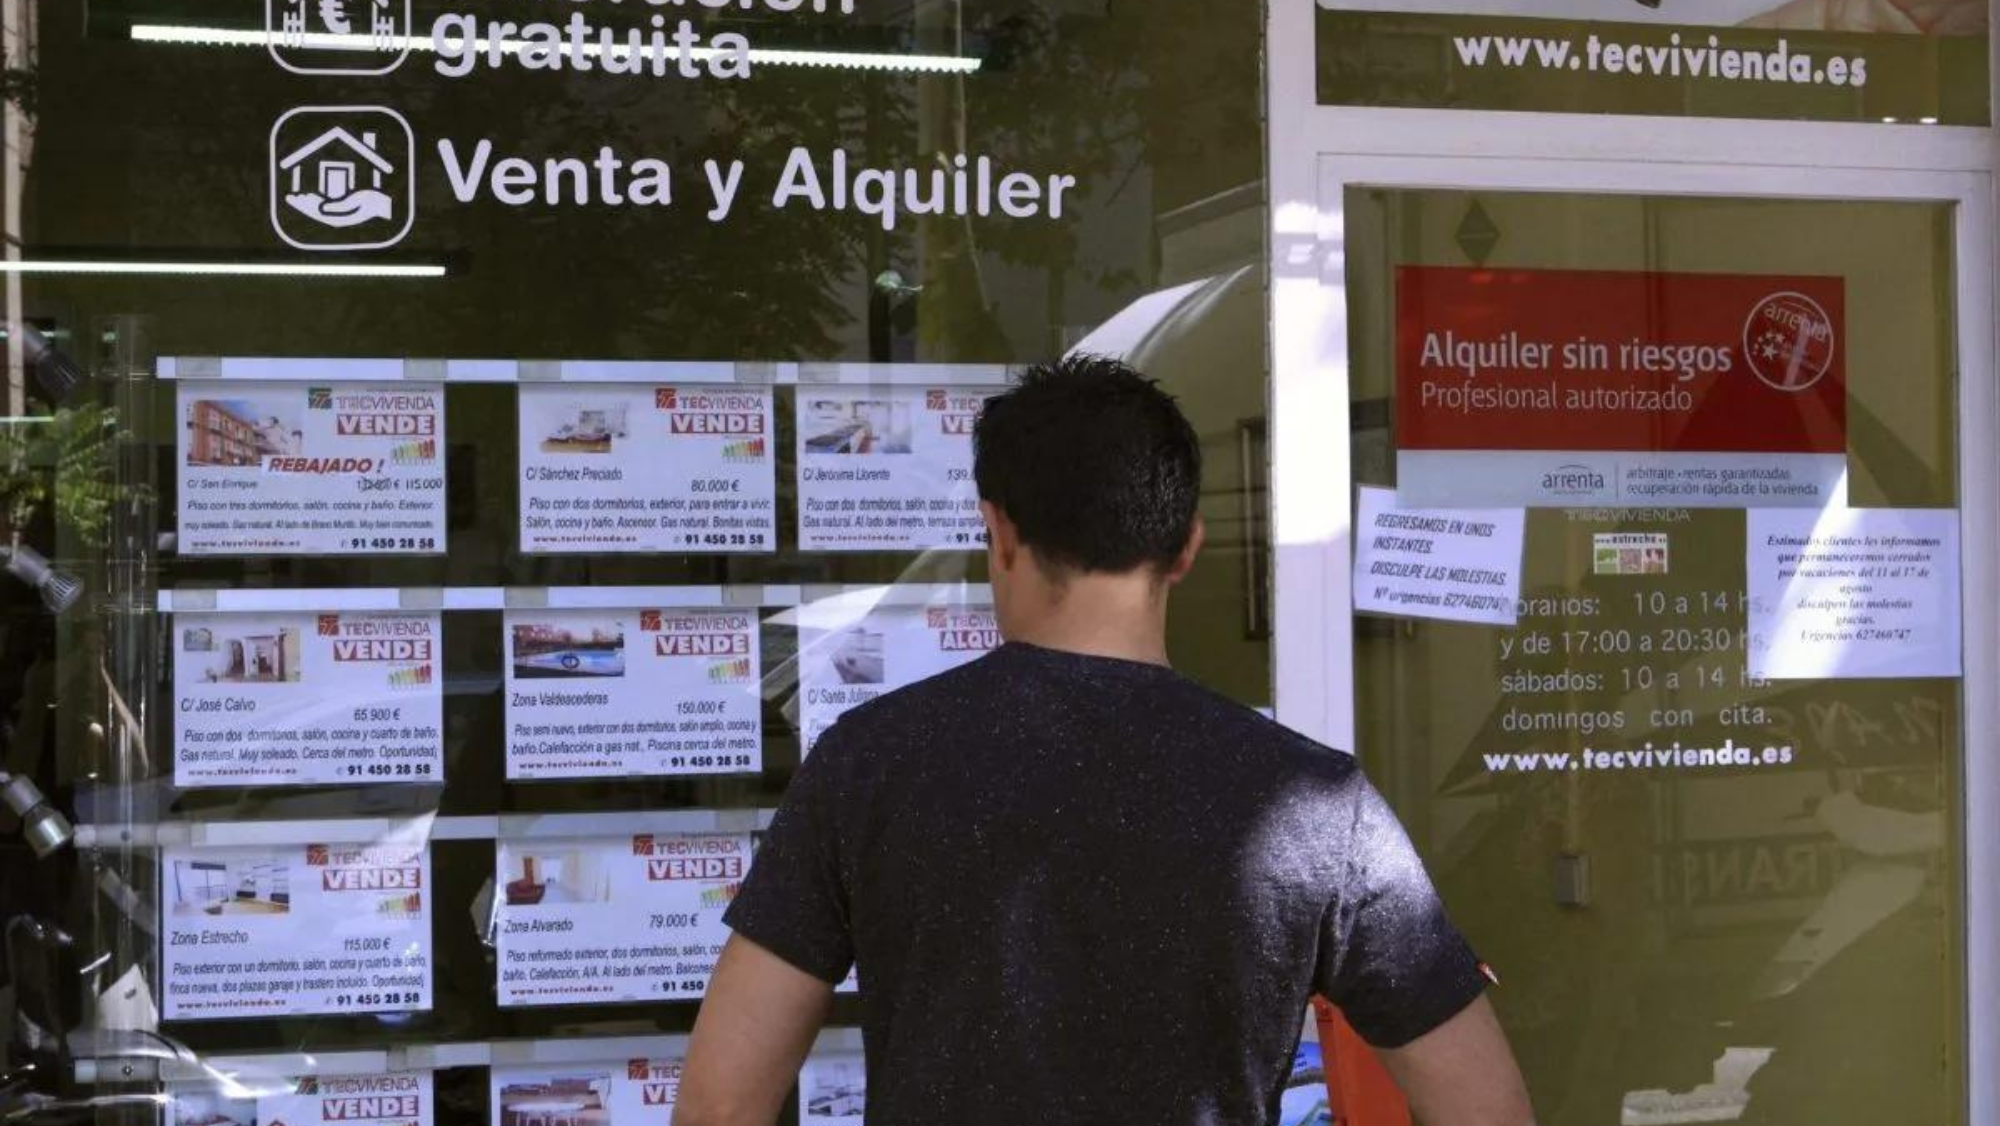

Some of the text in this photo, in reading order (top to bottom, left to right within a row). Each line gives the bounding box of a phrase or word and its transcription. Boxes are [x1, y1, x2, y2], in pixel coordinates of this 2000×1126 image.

[431, 12, 751, 79] gratuita
[1454, 33, 1867, 86] www.tecvivienda.es
[437, 138, 1076, 231] Venta y Alquiler
[1419, 330, 1732, 381] Alquiler sin riesgos
[678, 395, 764, 411] TECVIVIENDA
[1420, 381, 1693, 414] Profesional autorizado
[338, 415, 434, 434] VENDE
[672, 413, 764, 433] VENDE
[267, 456, 374, 475] REBAJADO
[1626, 466, 1675, 482] arbitraje
[730, 479, 741, 492] €
[1542, 471, 1604, 490] arrenta
[1741, 481, 1756, 495] de
[1758, 481, 1770, 495] la
[1772, 483, 1819, 496] vivienda
[1375, 512, 1496, 537] REGRESAMOS EN UNOS
[351, 538, 435, 549] 91 450 28 58
[685, 533, 765, 545] 91 450 28 58
[1777, 553, 1796, 564] que
[1371, 560, 1425, 579] DISCULPE
[1424, 565, 1448, 581] LAS
[1858, 566, 1874, 578] del
[1917, 566, 1931, 578] de
[1634, 591, 1666, 614] 10
[1675, 598, 1689, 614] a
[1701, 591, 1729, 614] 14
[344, 621, 431, 637] TECVIVIENDA
[664, 615, 750, 632] TECVIVIENDA
[334, 640, 432, 661] VENDE
[656, 635, 749, 655] VENDE
[1500, 638, 1515, 659] y
[1521, 629, 1551, 654] de
[1561, 628, 1630, 654] 17:00
[1639, 635, 1653, 652] a
[1661, 627, 1731, 652] 20:30
[1500, 667, 1604, 693] sábados:
[1620, 665, 1654, 690] 10
[1666, 672, 1680, 688] a
[1695, 666, 1724, 689] 14
[181, 697, 257, 712] C/ José Calvo
[511, 692, 538, 707] Zona
[718, 700, 727, 713] €
[392, 708, 401, 720] €
[1501, 707, 1625, 735] domingos
[1651, 707, 1694, 728] con
[1719, 702, 1773, 726] cita.
[670, 755, 751, 768] 91 450 28 58
[1482, 739, 1794, 771] www.tecvivienda.es
[348, 764, 431, 776] 91 450 28 58
[656, 840, 742, 856] TECVIVIENDA
[648, 858, 742, 880] VENDE
[323, 869, 420, 890] VENDE
[504, 918, 575, 934] Zona Alvarado
[690, 913, 700, 927] €
[171, 929, 250, 946] Zona Estrecho
[383, 937, 392, 950] €
[662, 981, 705, 992] 91 450
[337, 992, 420, 1006] 91 450 28 58
[320, 1077, 420, 1094] TECVIVIENDA
[323, 1097, 419, 1120] VENDE
